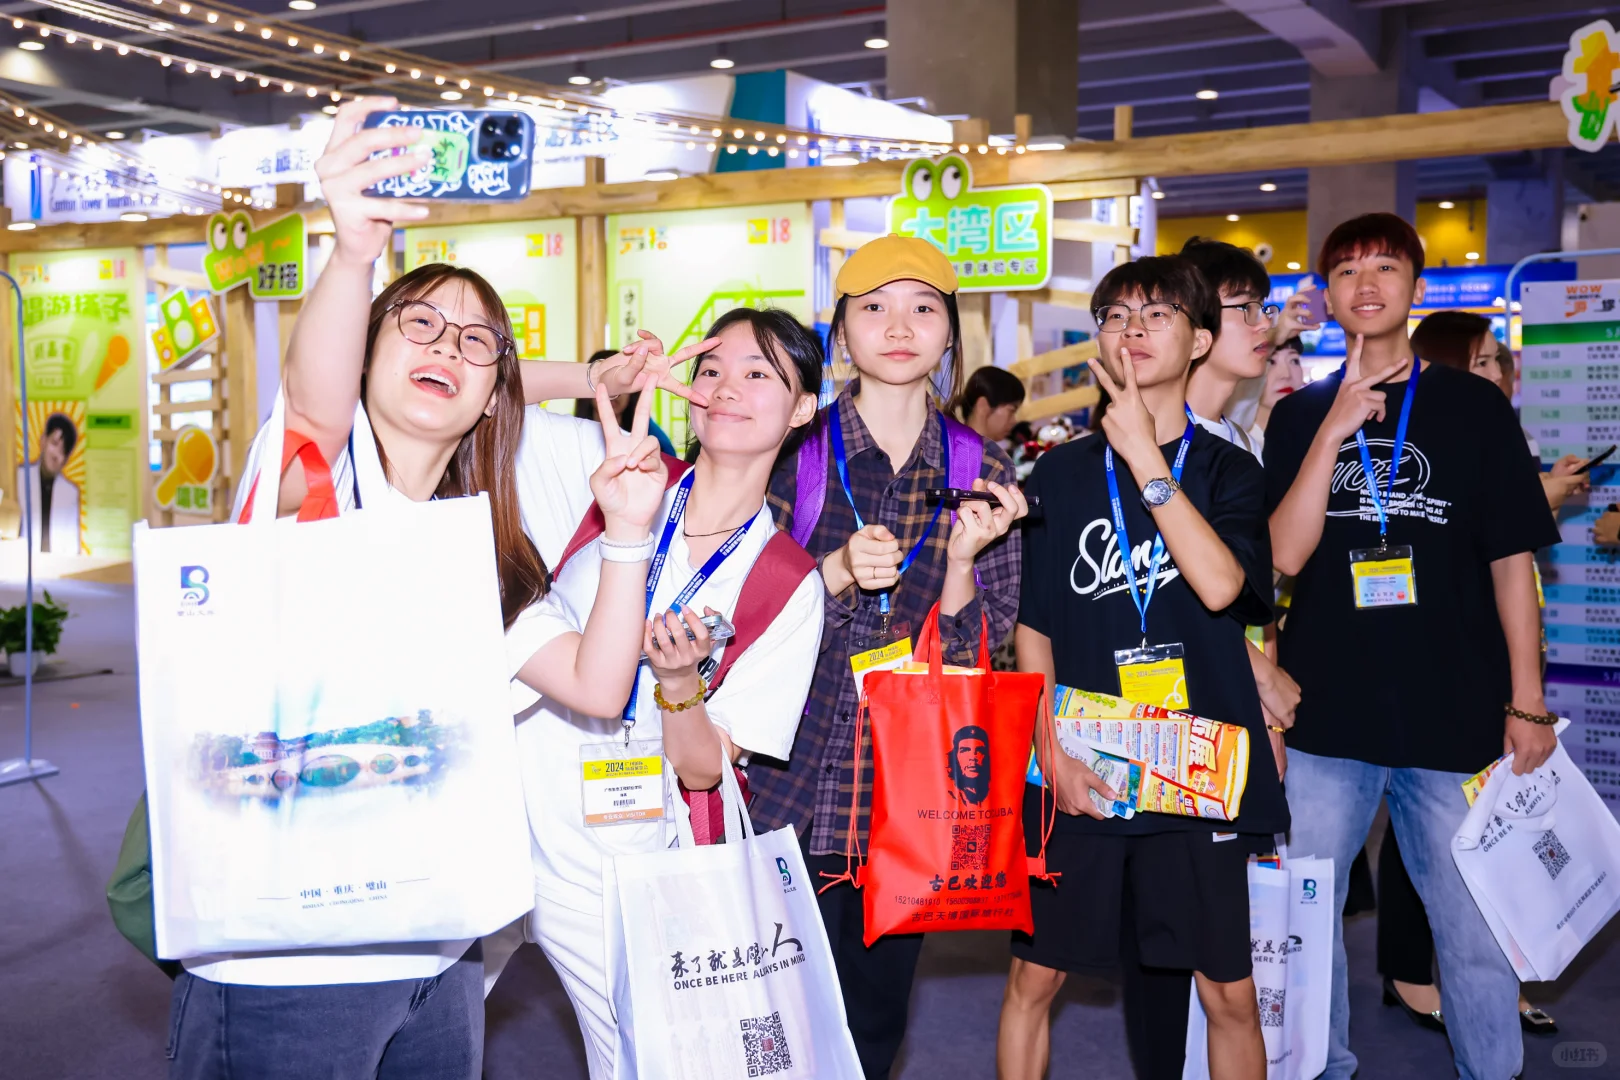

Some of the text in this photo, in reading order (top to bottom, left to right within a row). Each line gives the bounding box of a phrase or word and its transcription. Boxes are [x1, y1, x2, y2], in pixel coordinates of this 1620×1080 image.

[901, 201, 1039, 255] 大湾区
[258, 263, 298, 291] 好搭
[1565, 284, 1603, 295] WOW
[605, 761, 624, 773] 2024
[917, 810, 976, 819] WELCOME
[1483, 835, 1500, 853] ONCE
[929, 870, 1007, 891] 古巴欢迎您
[674, 978, 703, 990] ONCE
[706, 975, 719, 986] BE
[721, 971, 748, 984] HERE
[780, 958, 790, 970] IN
